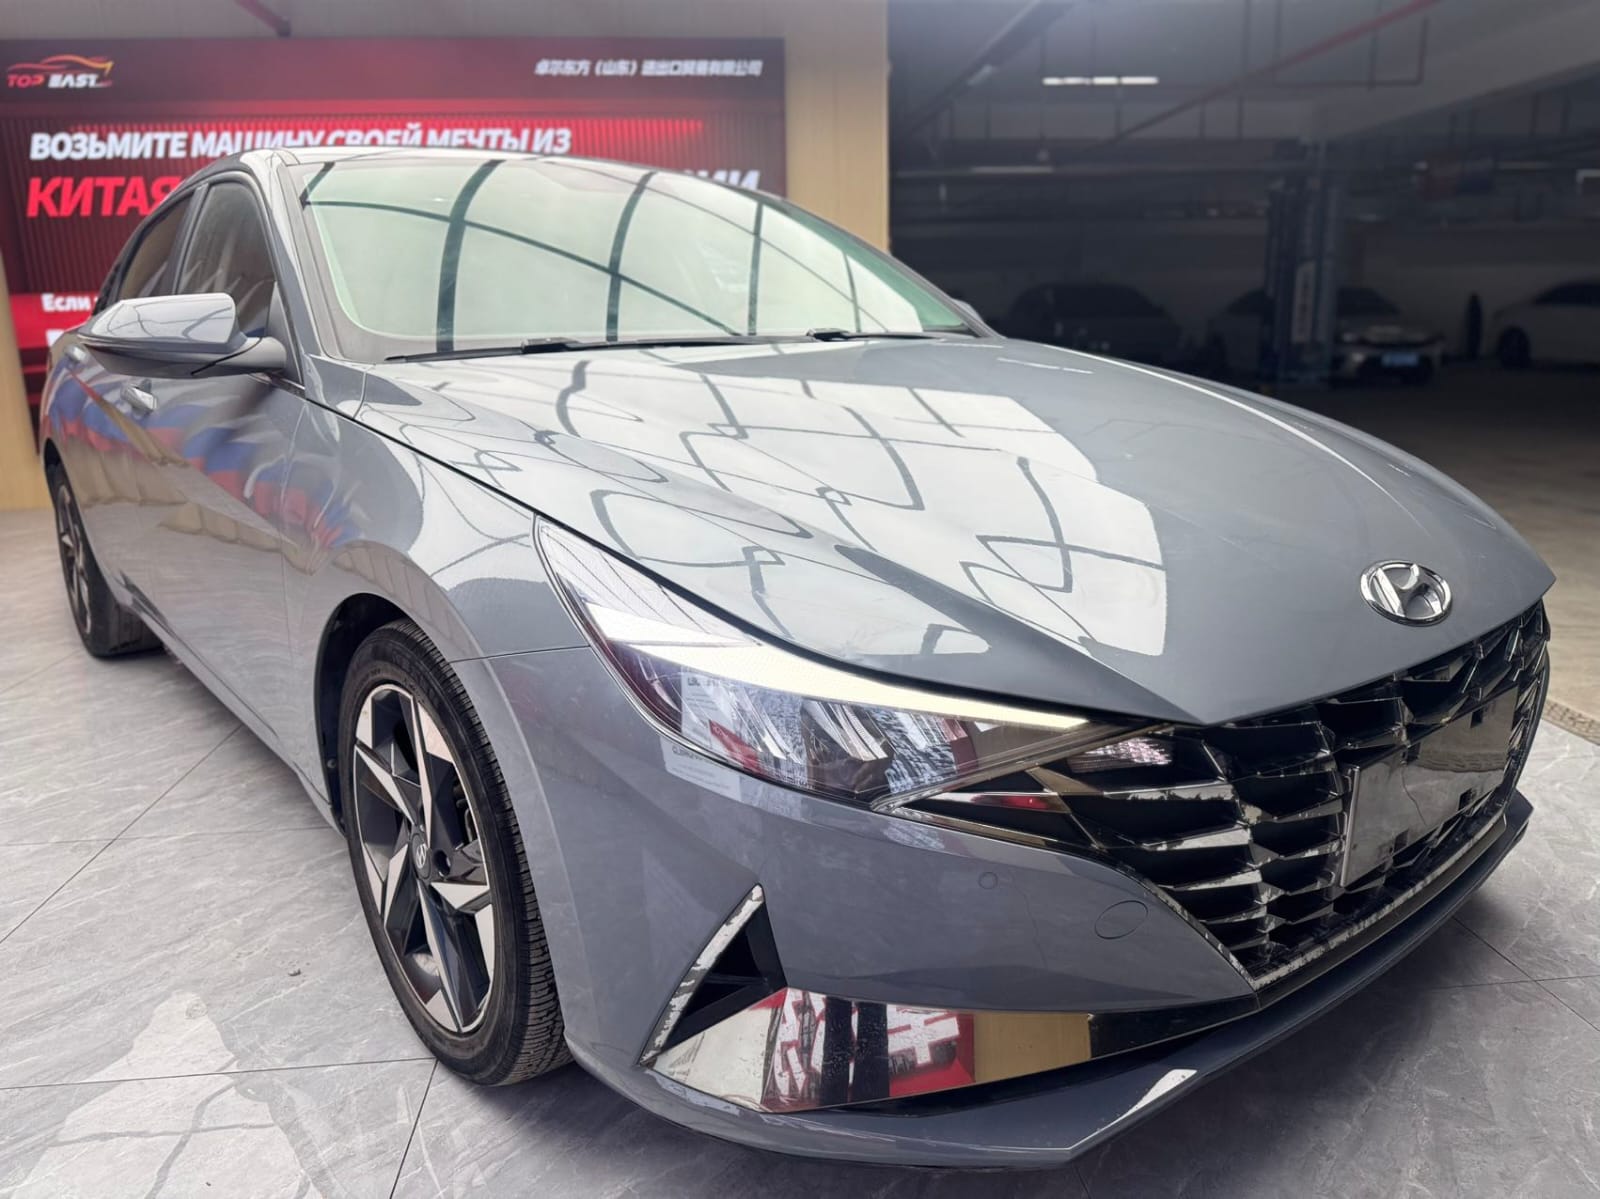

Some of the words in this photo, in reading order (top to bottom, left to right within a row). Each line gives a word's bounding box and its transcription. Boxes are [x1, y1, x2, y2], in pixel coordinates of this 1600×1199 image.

[7, 73, 45, 88] TOP
[47, 73, 98, 88] EAST
[29, 132, 188, 160] ВОЗЬМИТЕ
[531, 128, 571, 154] ИЗ
[41, 293, 92, 313] Если
